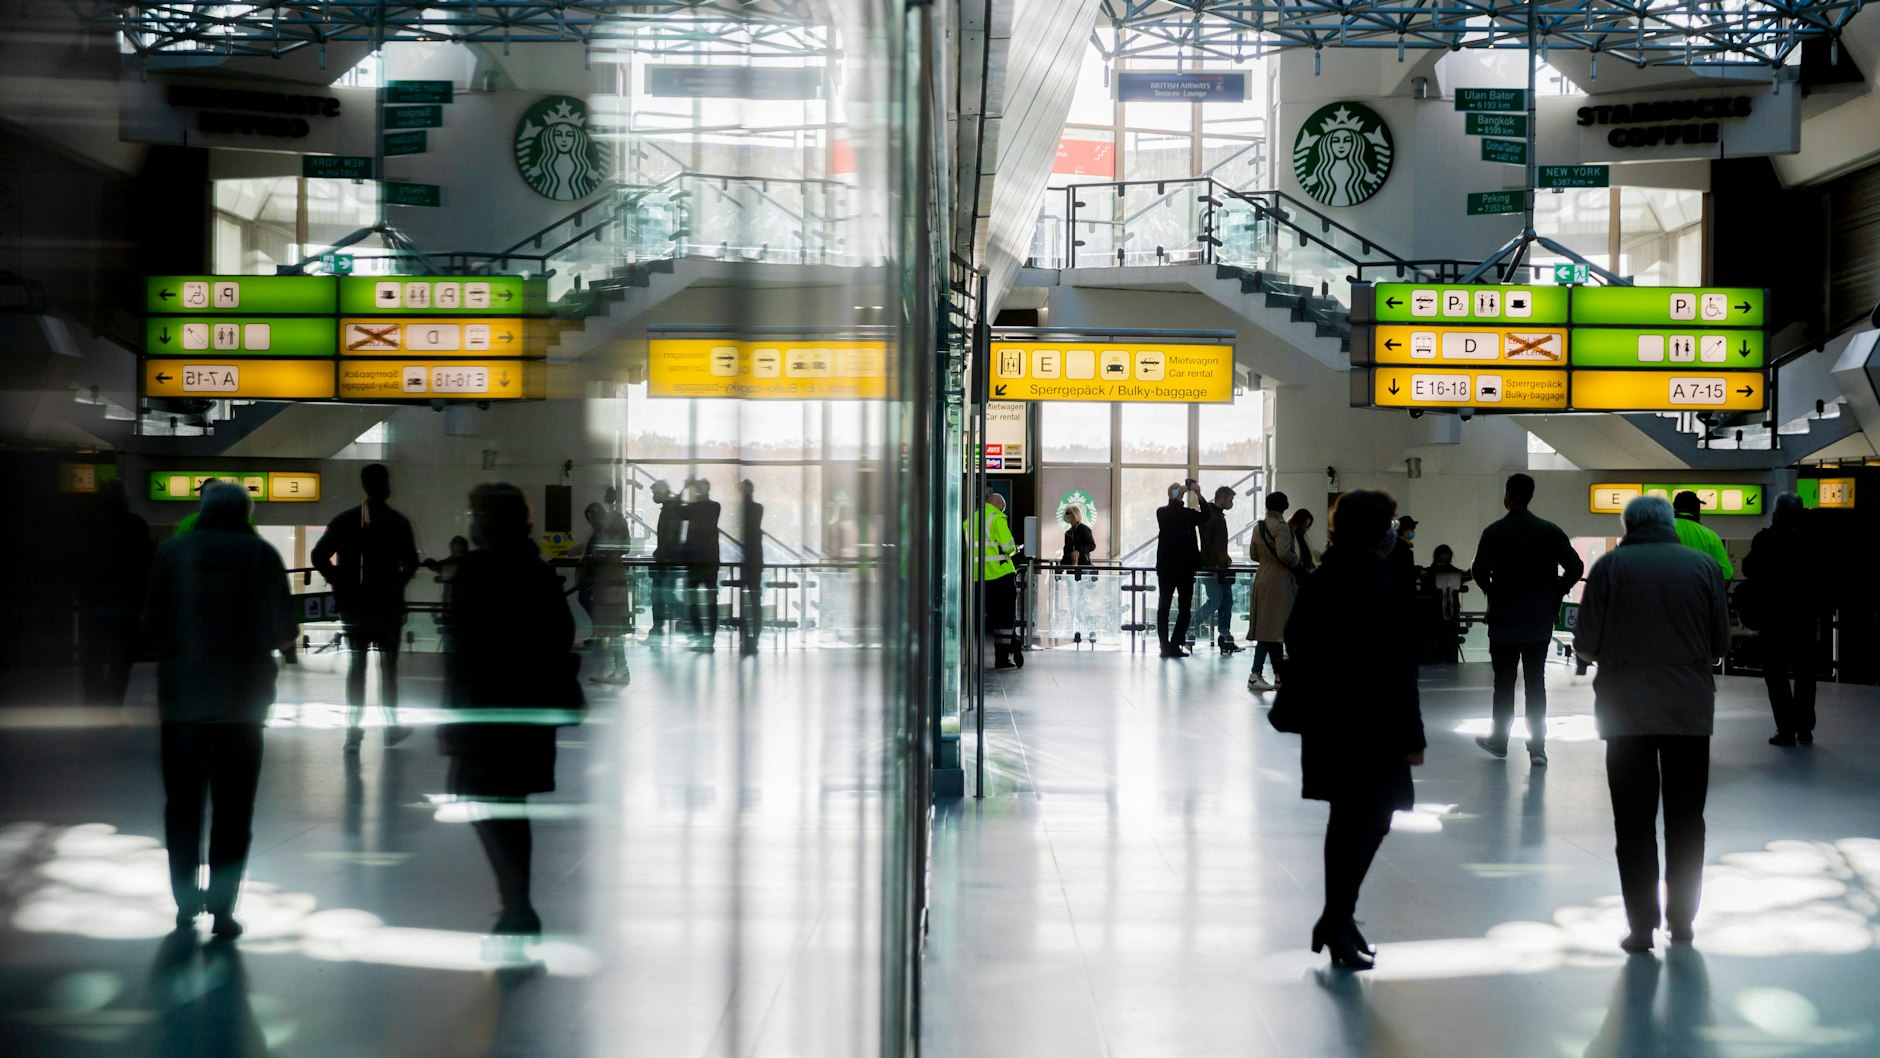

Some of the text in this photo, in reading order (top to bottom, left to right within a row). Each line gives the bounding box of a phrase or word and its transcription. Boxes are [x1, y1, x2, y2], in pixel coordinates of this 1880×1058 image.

[1183, 90, 1207, 98] Lounge
[1464, 91, 1516, 100] Ulan Bator
[1477, 115, 1515, 128] Bangkok
[1502, 127, 1514, 135] km
[1546, 167, 1601, 176] NEW YORK
[1482, 193, 1510, 204] Peking
[1502, 204, 1513, 212] km
[1465, 338, 1477, 353] D
[1041, 356, 1053, 372] E
[1168, 356, 1219, 367] Mietwagen
[1168, 369, 1213, 378] Car rental
[1416, 381, 1467, 395] E 16-18
[1506, 379, 1563, 389] Sperrgepäck
[1030, 384, 1105, 398] Sperrgepäck
[1118, 385, 1207, 399] Bulky-baggage
[1506, 390, 1565, 401] Bulky-baggage
[1673, 384, 1723, 398] A 7-15
[987, 403, 1024, 411] Mietwagen
[1612, 493, 1620, 504] E
